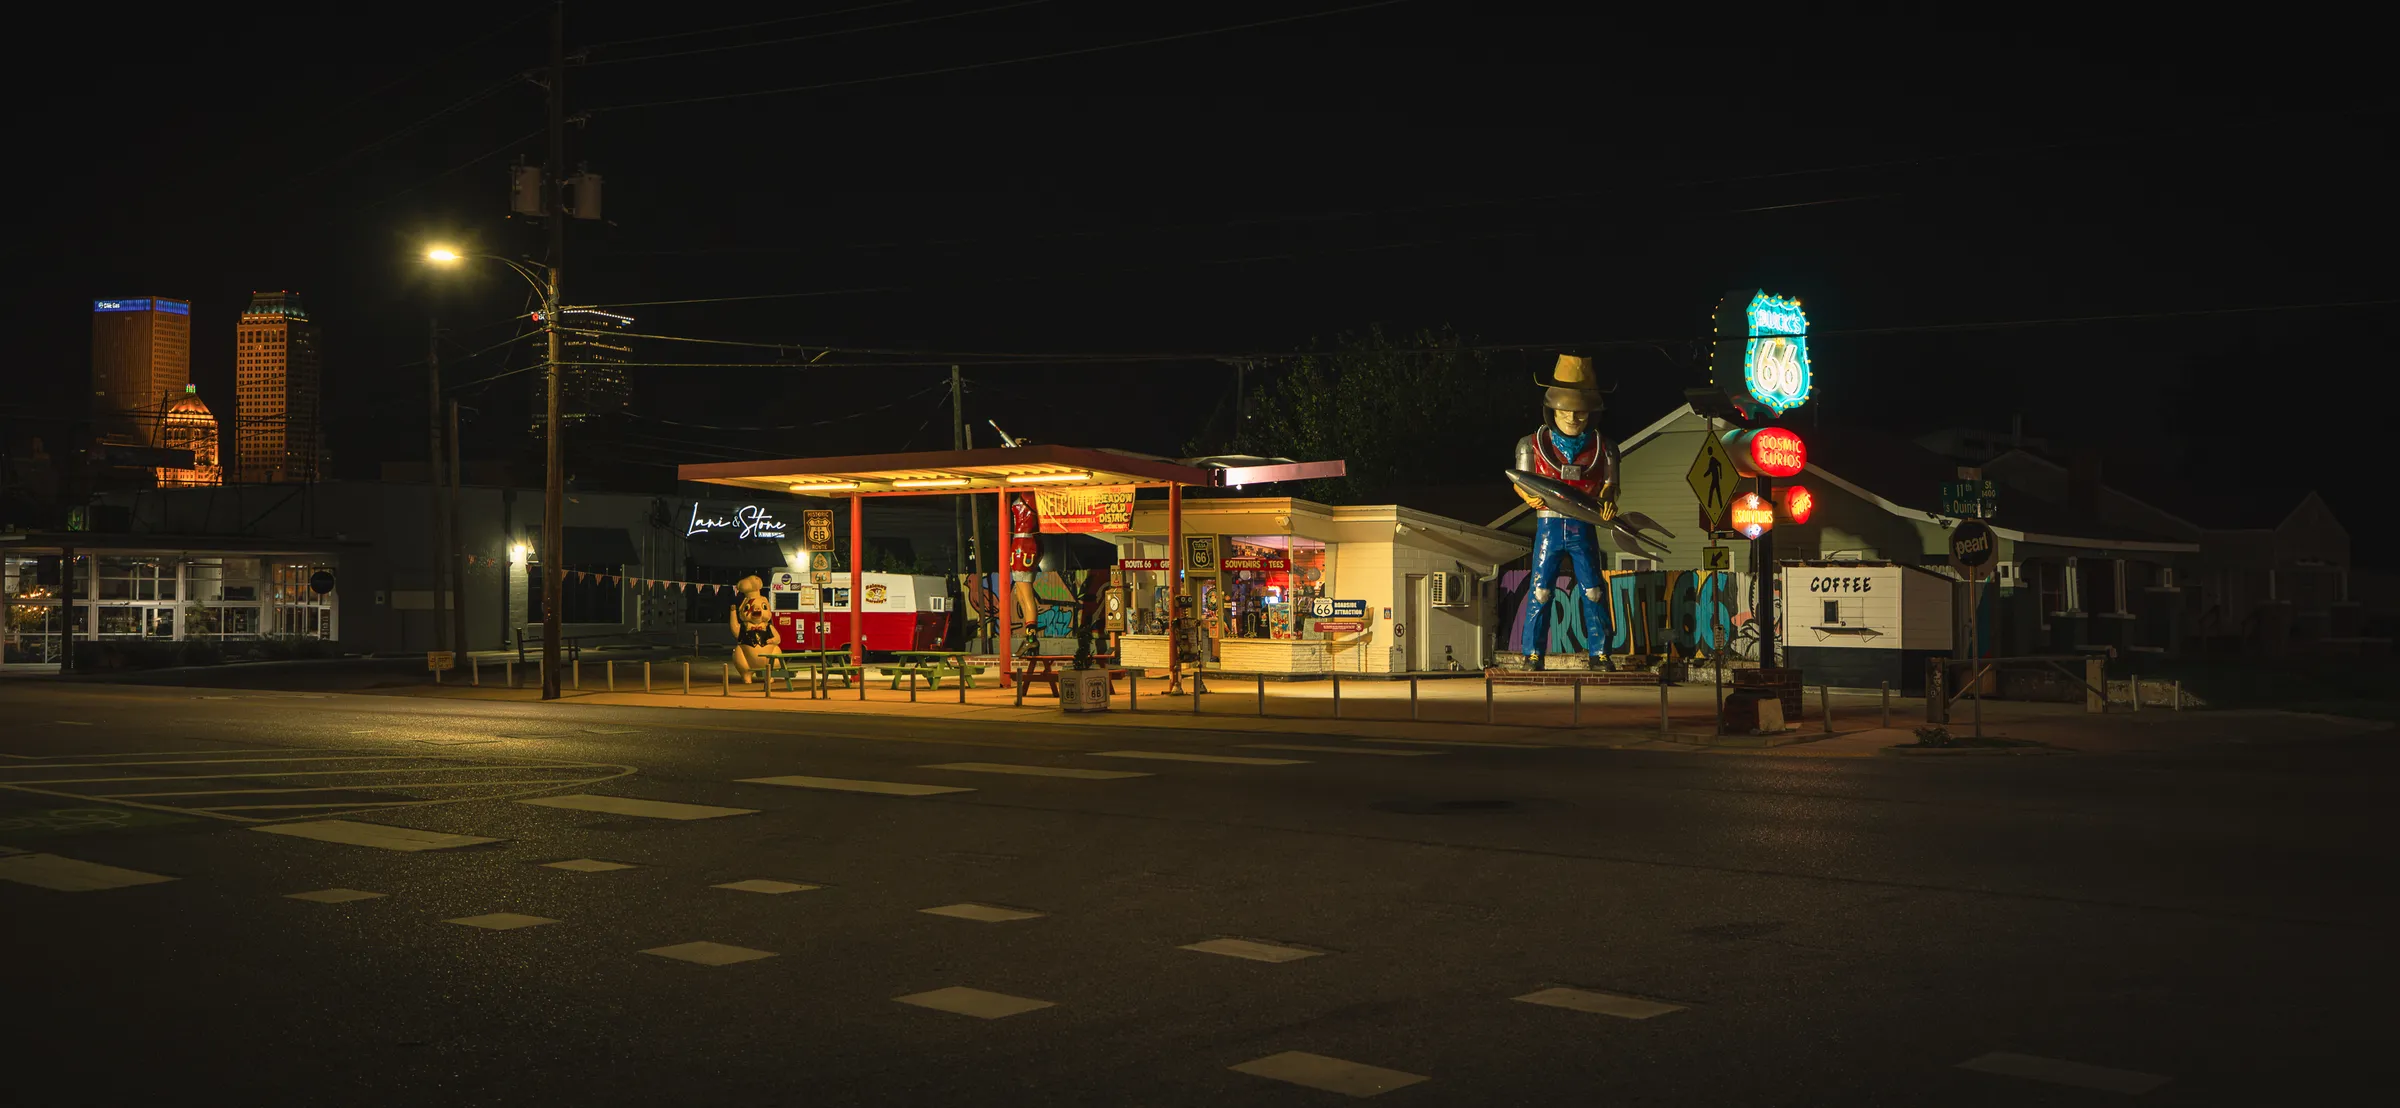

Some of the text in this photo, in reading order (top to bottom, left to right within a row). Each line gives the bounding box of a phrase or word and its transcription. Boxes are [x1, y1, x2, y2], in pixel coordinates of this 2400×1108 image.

[1757, 309, 1801, 335] BUCK'S
[1756, 339, 1802, 397] 66
[1760, 435, 1802, 453] COSMIC
[1761, 450, 1802, 469] CURIOS
[1943, 487, 1948, 496] E
[1984, 480, 1992, 489] St
[1037, 494, 1096, 516] WELCOME!
[1104, 503, 1126, 513] GOLD
[1953, 500, 1980, 515] Quinc
[687, 502, 786, 539] Lani & Stone
[813, 531, 825, 540] 66
[1955, 532, 1989, 560] pearl
[1124, 560, 1143, 568] ROUTE
[1144, 560, 1152, 568] 66
[1195, 552, 1206, 564] 66
[1225, 560, 1284, 568] SOUVENIRS TEES
[815, 572, 827, 582] 66
[1810, 576, 1872, 593] COFFEE
[1316, 604, 1331, 615] 66
[1671, 571, 1730, 652] 66
